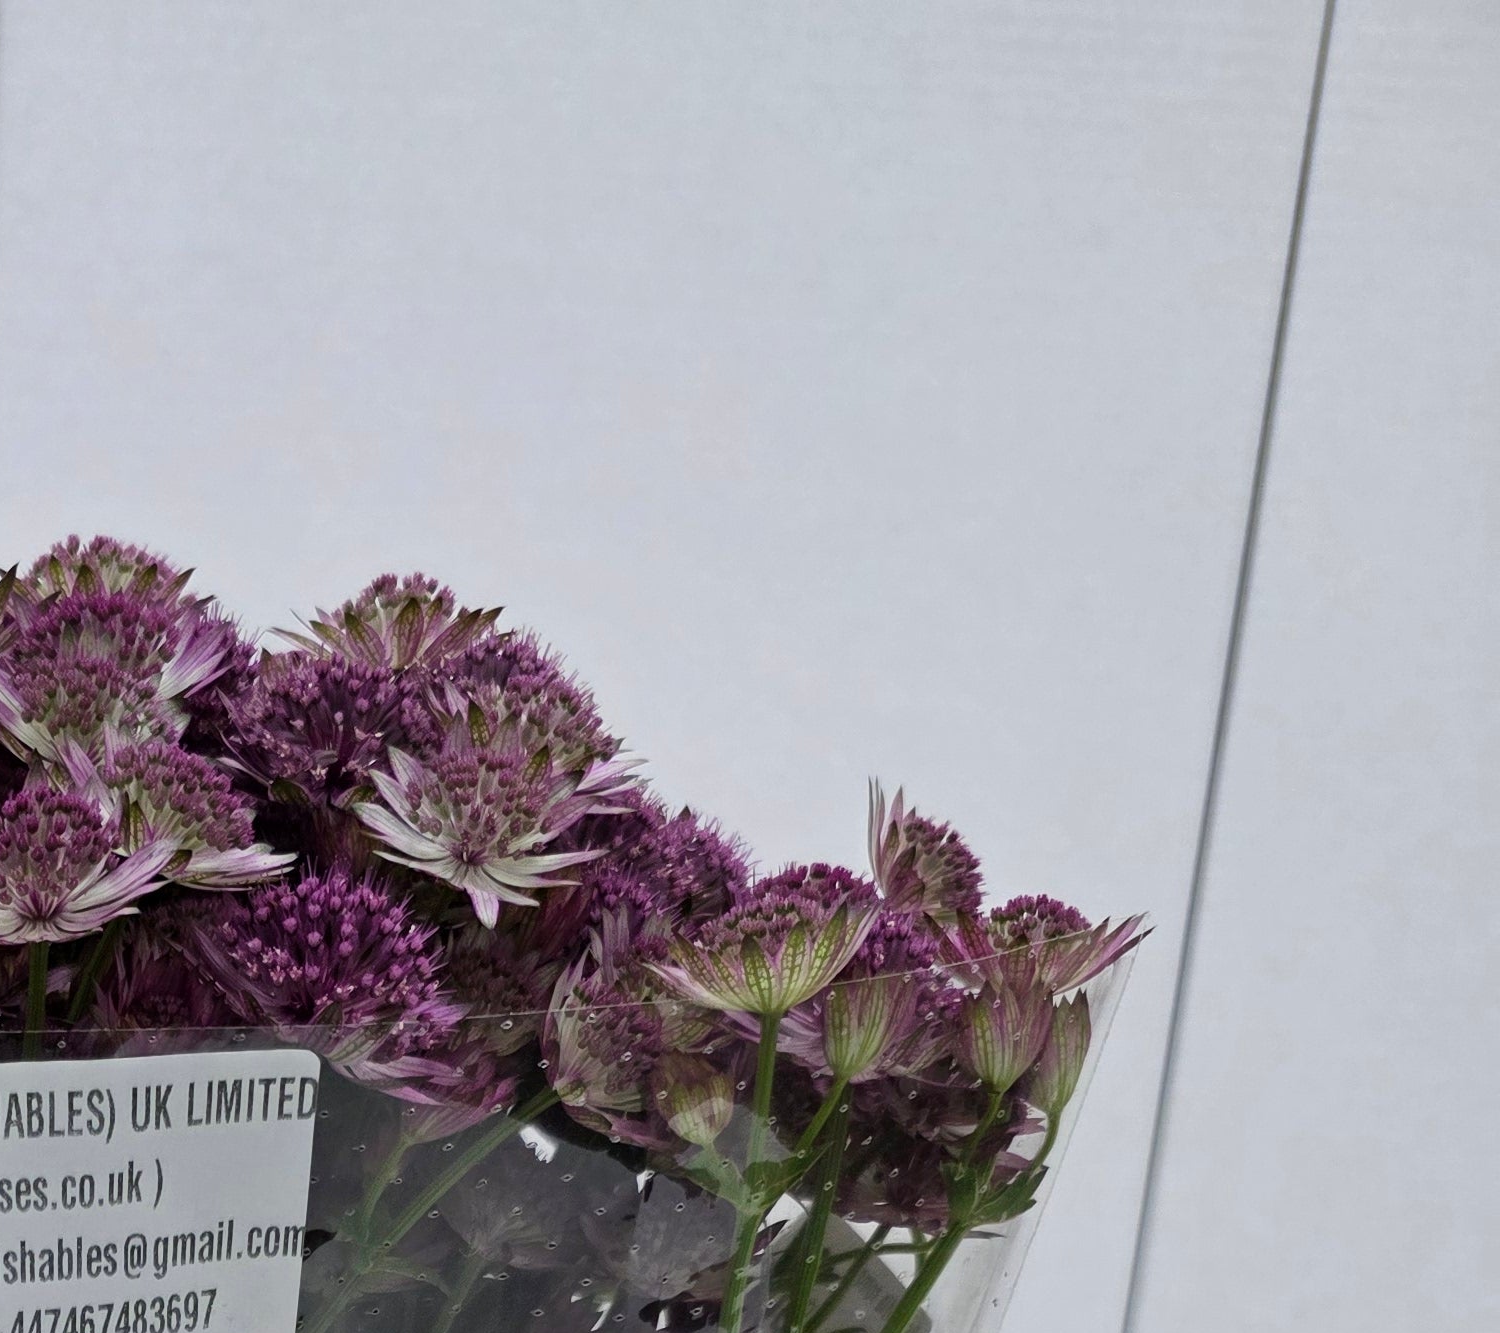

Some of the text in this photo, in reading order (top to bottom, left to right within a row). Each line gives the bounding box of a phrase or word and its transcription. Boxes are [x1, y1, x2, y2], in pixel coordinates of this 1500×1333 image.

[132, 1085, 173, 1132] UK
[187, 1076, 319, 1126] LIMITED
[154, 1158, 163, 1208] )
